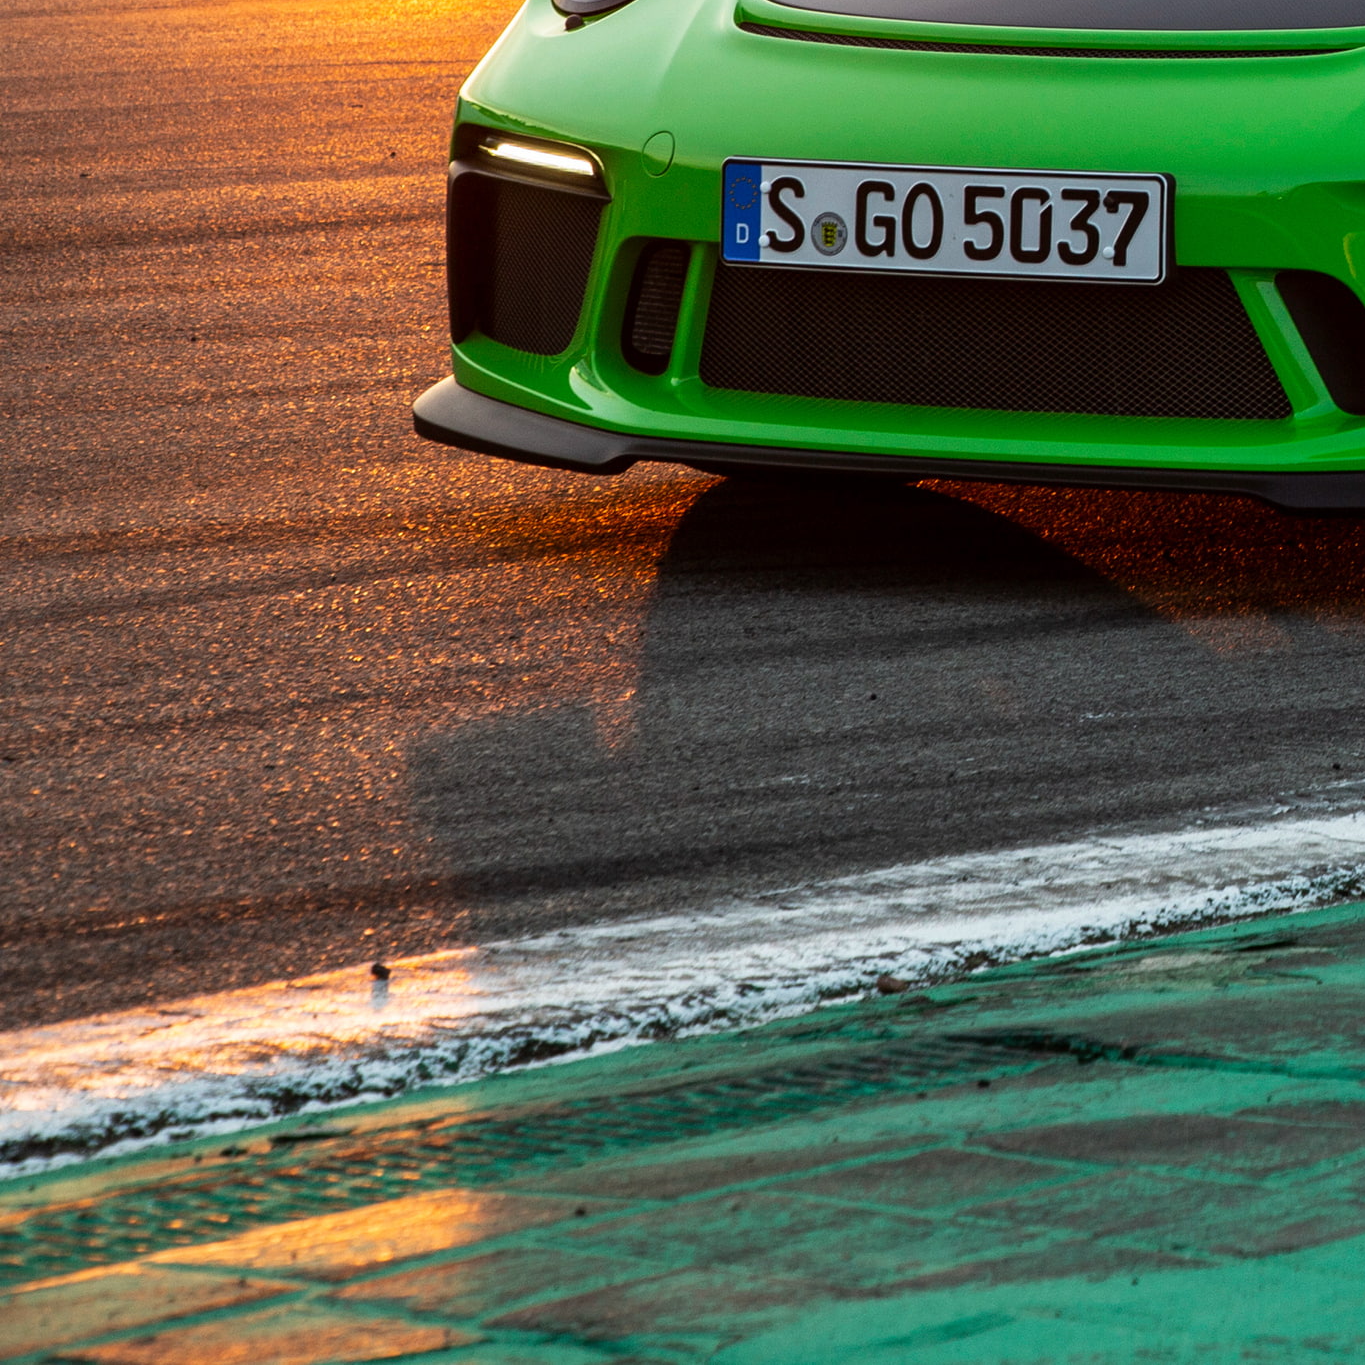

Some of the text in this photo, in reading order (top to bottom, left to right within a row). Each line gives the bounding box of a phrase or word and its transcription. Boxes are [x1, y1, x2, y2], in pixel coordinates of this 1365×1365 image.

[736, 223, 750, 244] D
[765, 176, 806, 253] S
[855, 179, 944, 260] GO
[963, 185, 1150, 267] 5037
